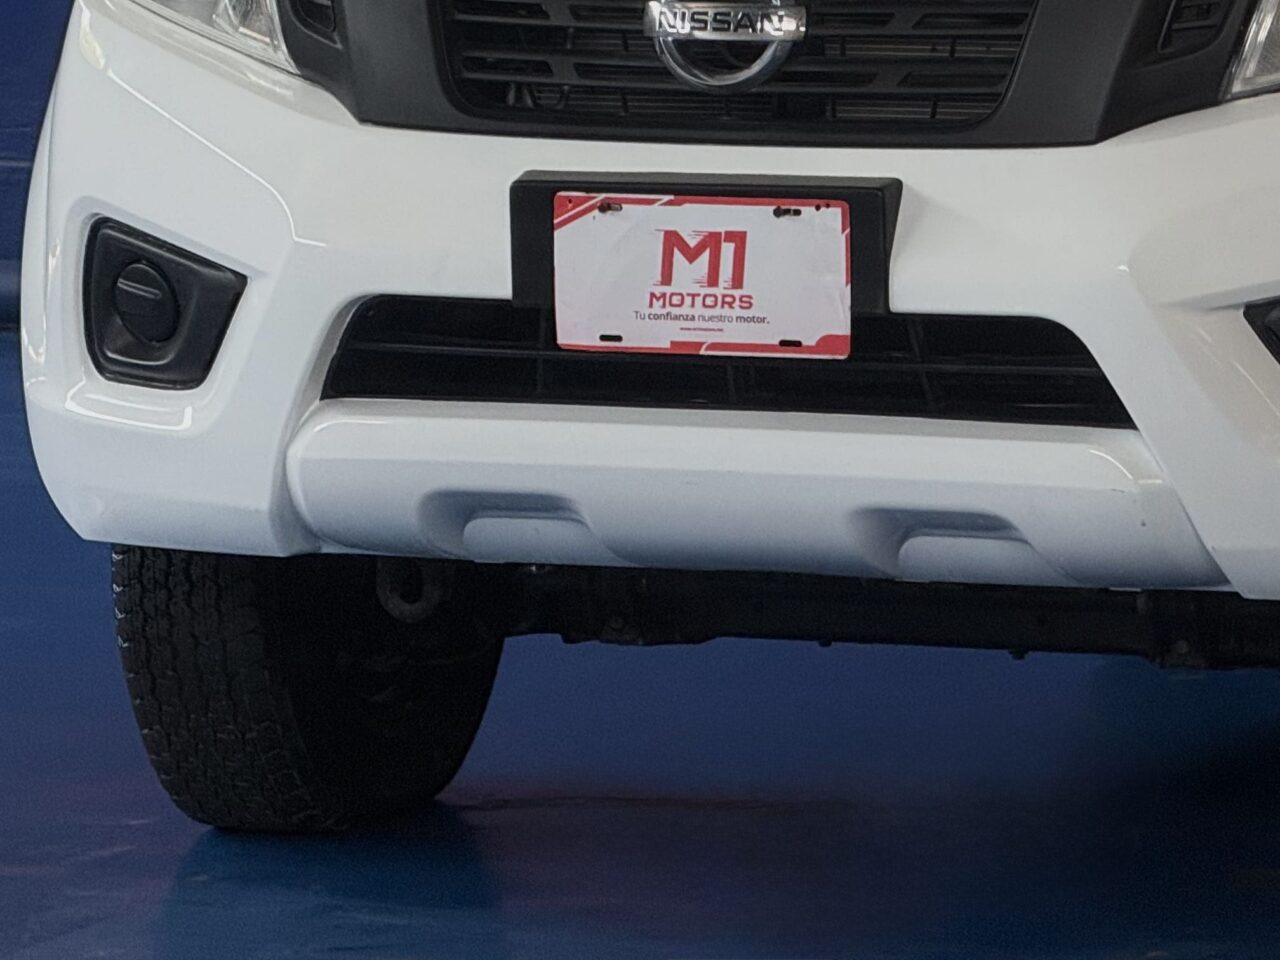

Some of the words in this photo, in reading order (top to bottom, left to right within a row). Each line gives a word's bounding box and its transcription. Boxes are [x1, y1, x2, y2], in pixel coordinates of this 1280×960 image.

[657, 7, 785, 36] NISSAN
[653, 229, 748, 290] M1
[648, 291, 754, 310] MOTORS
[634, 310, 646, 321] Tu
[647, 311, 696, 322] confianza
[697, 314, 734, 324] nuestro
[735, 315, 771, 325] motor.
